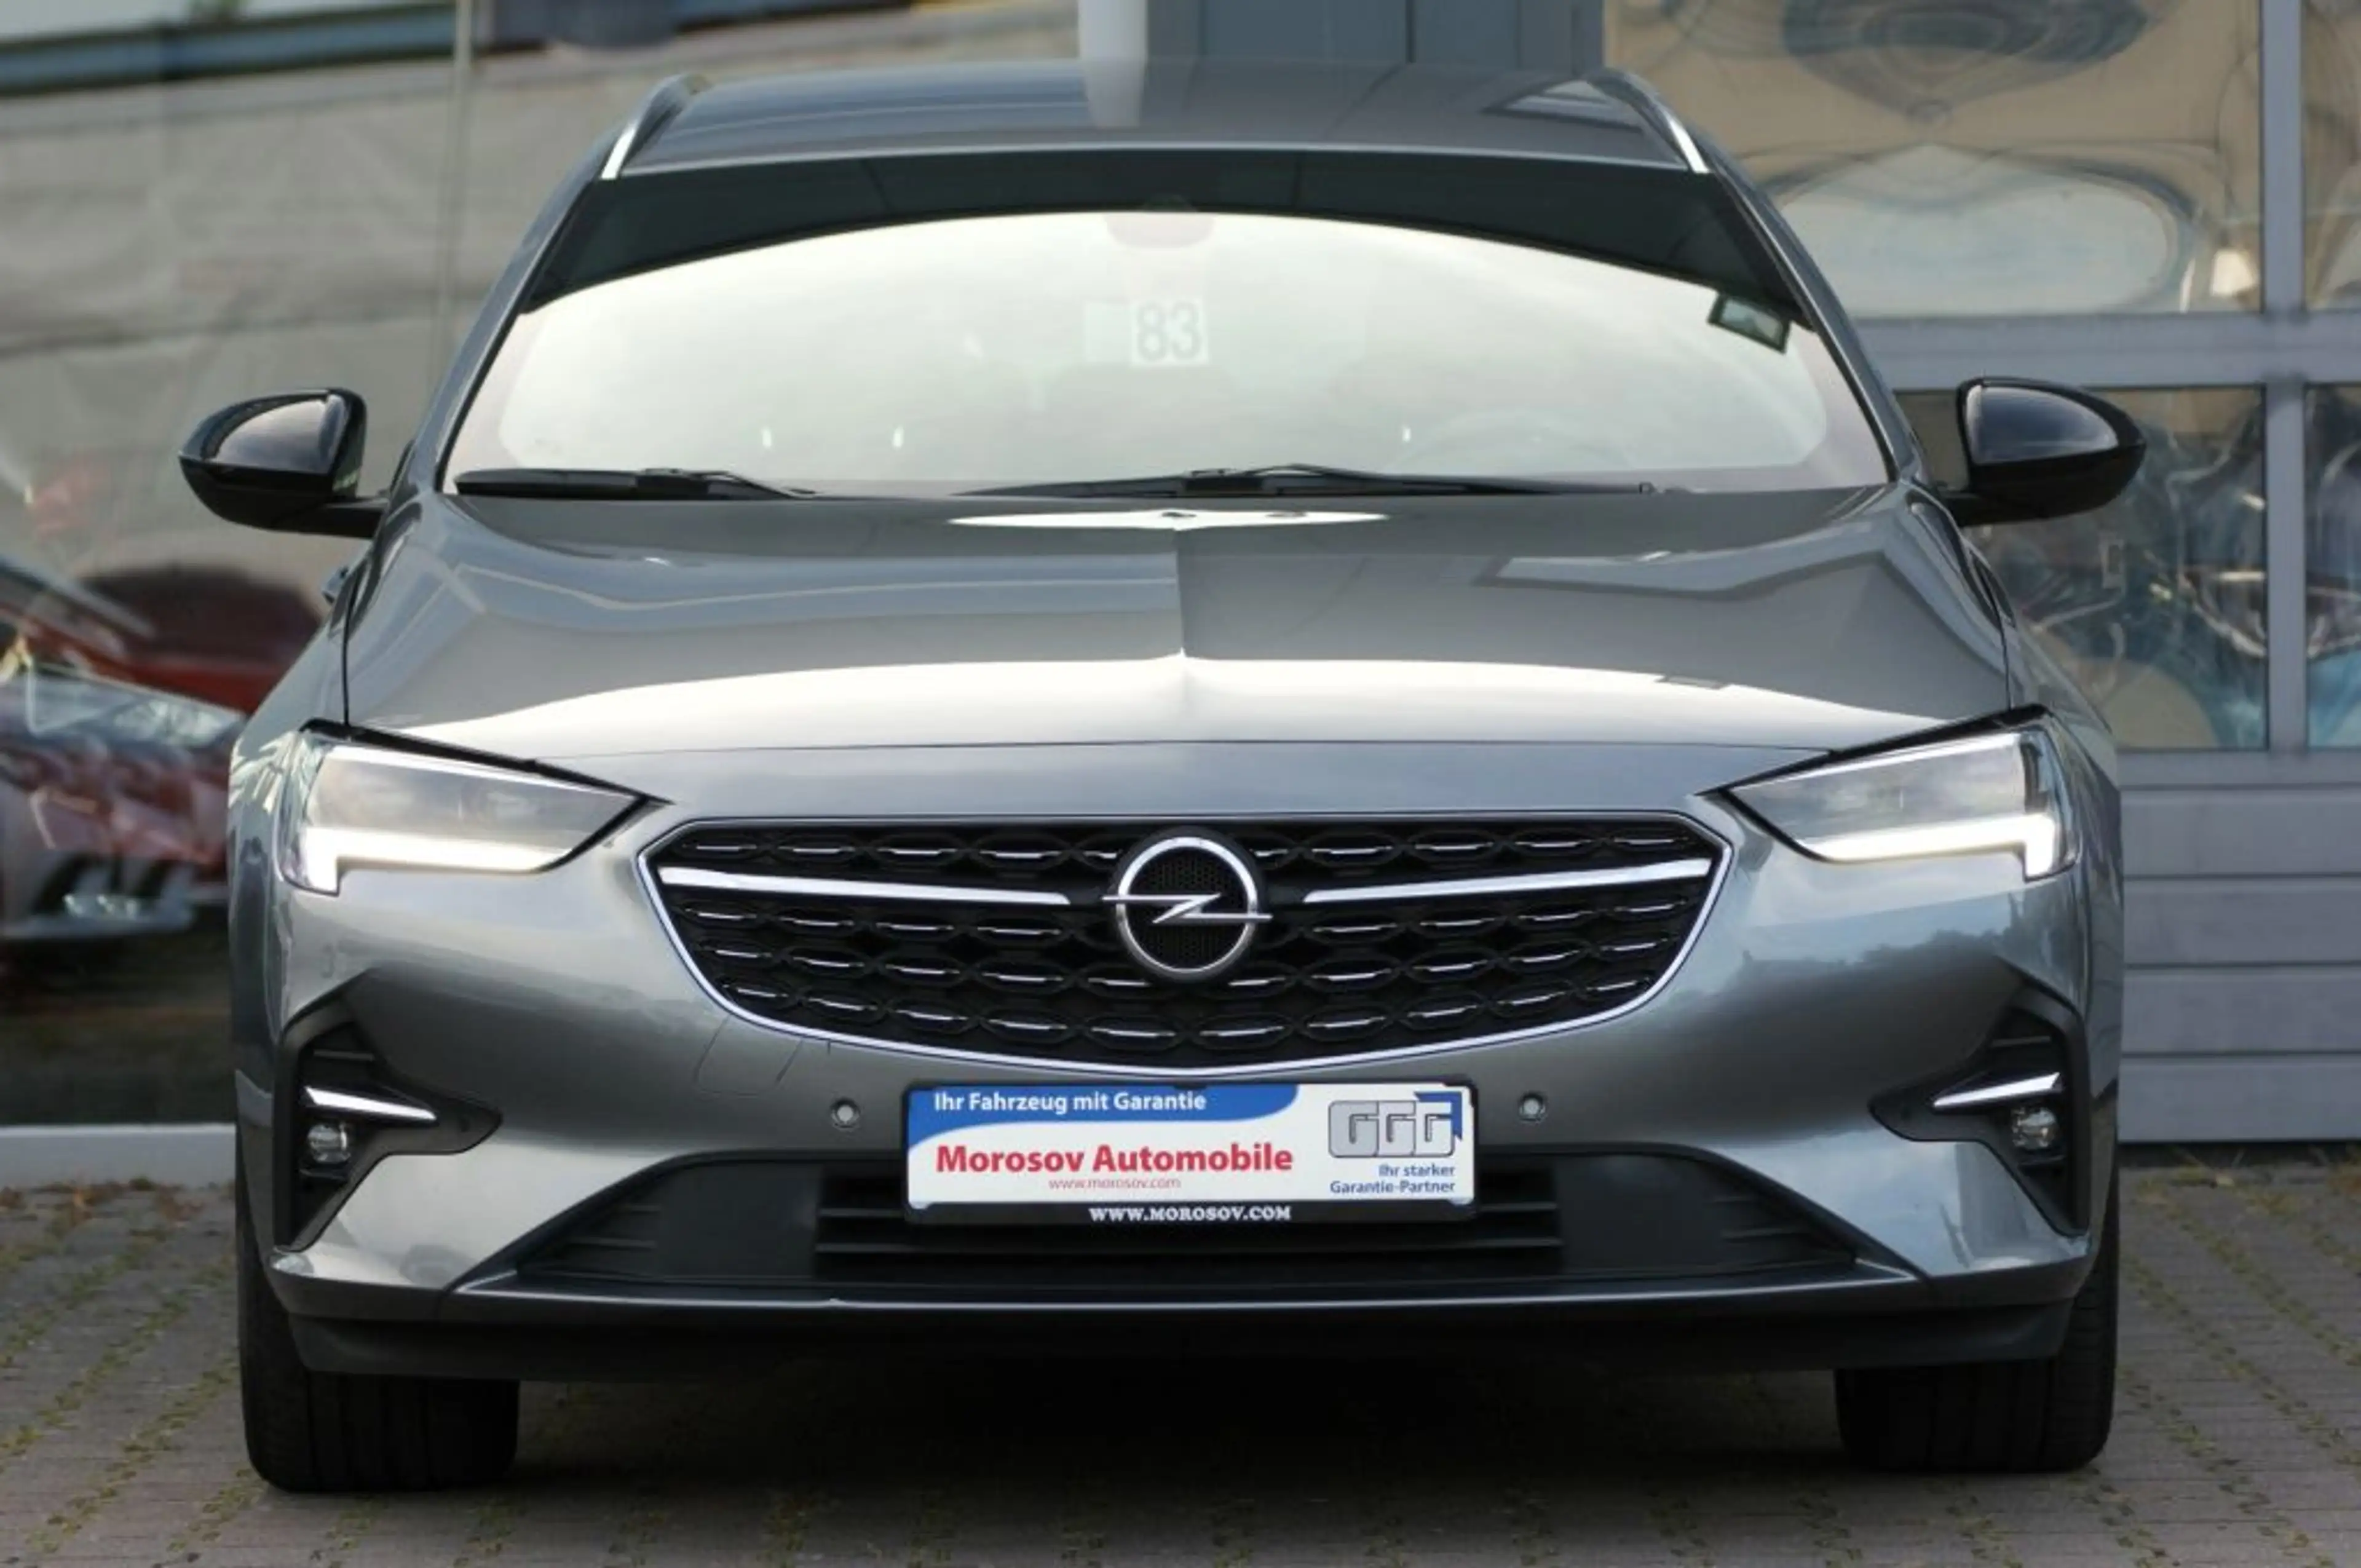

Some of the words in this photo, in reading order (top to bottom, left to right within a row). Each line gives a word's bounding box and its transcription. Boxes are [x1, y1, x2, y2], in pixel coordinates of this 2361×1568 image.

[935, 1093, 963, 1111] Ihr
[970, 1092, 1067, 1114] Fahrzeug
[1074, 1093, 1107, 1111] mit
[1113, 1091, 1207, 1111] Garantie
[1328, 1100, 1455, 1158] GGG
[936, 1145, 1084, 1172] Morosov
[1093, 1142, 1293, 1172] Automobile
[1378, 1164, 1399, 1176] Ihr
[1403, 1163, 1456, 1177] starker
[1048, 1178, 1180, 1189] www.morosov.com
[1330, 1180, 1456, 1194] Garantie-Partner
[1088, 1205, 1291, 1222] WWW.MOROSOV.COM
